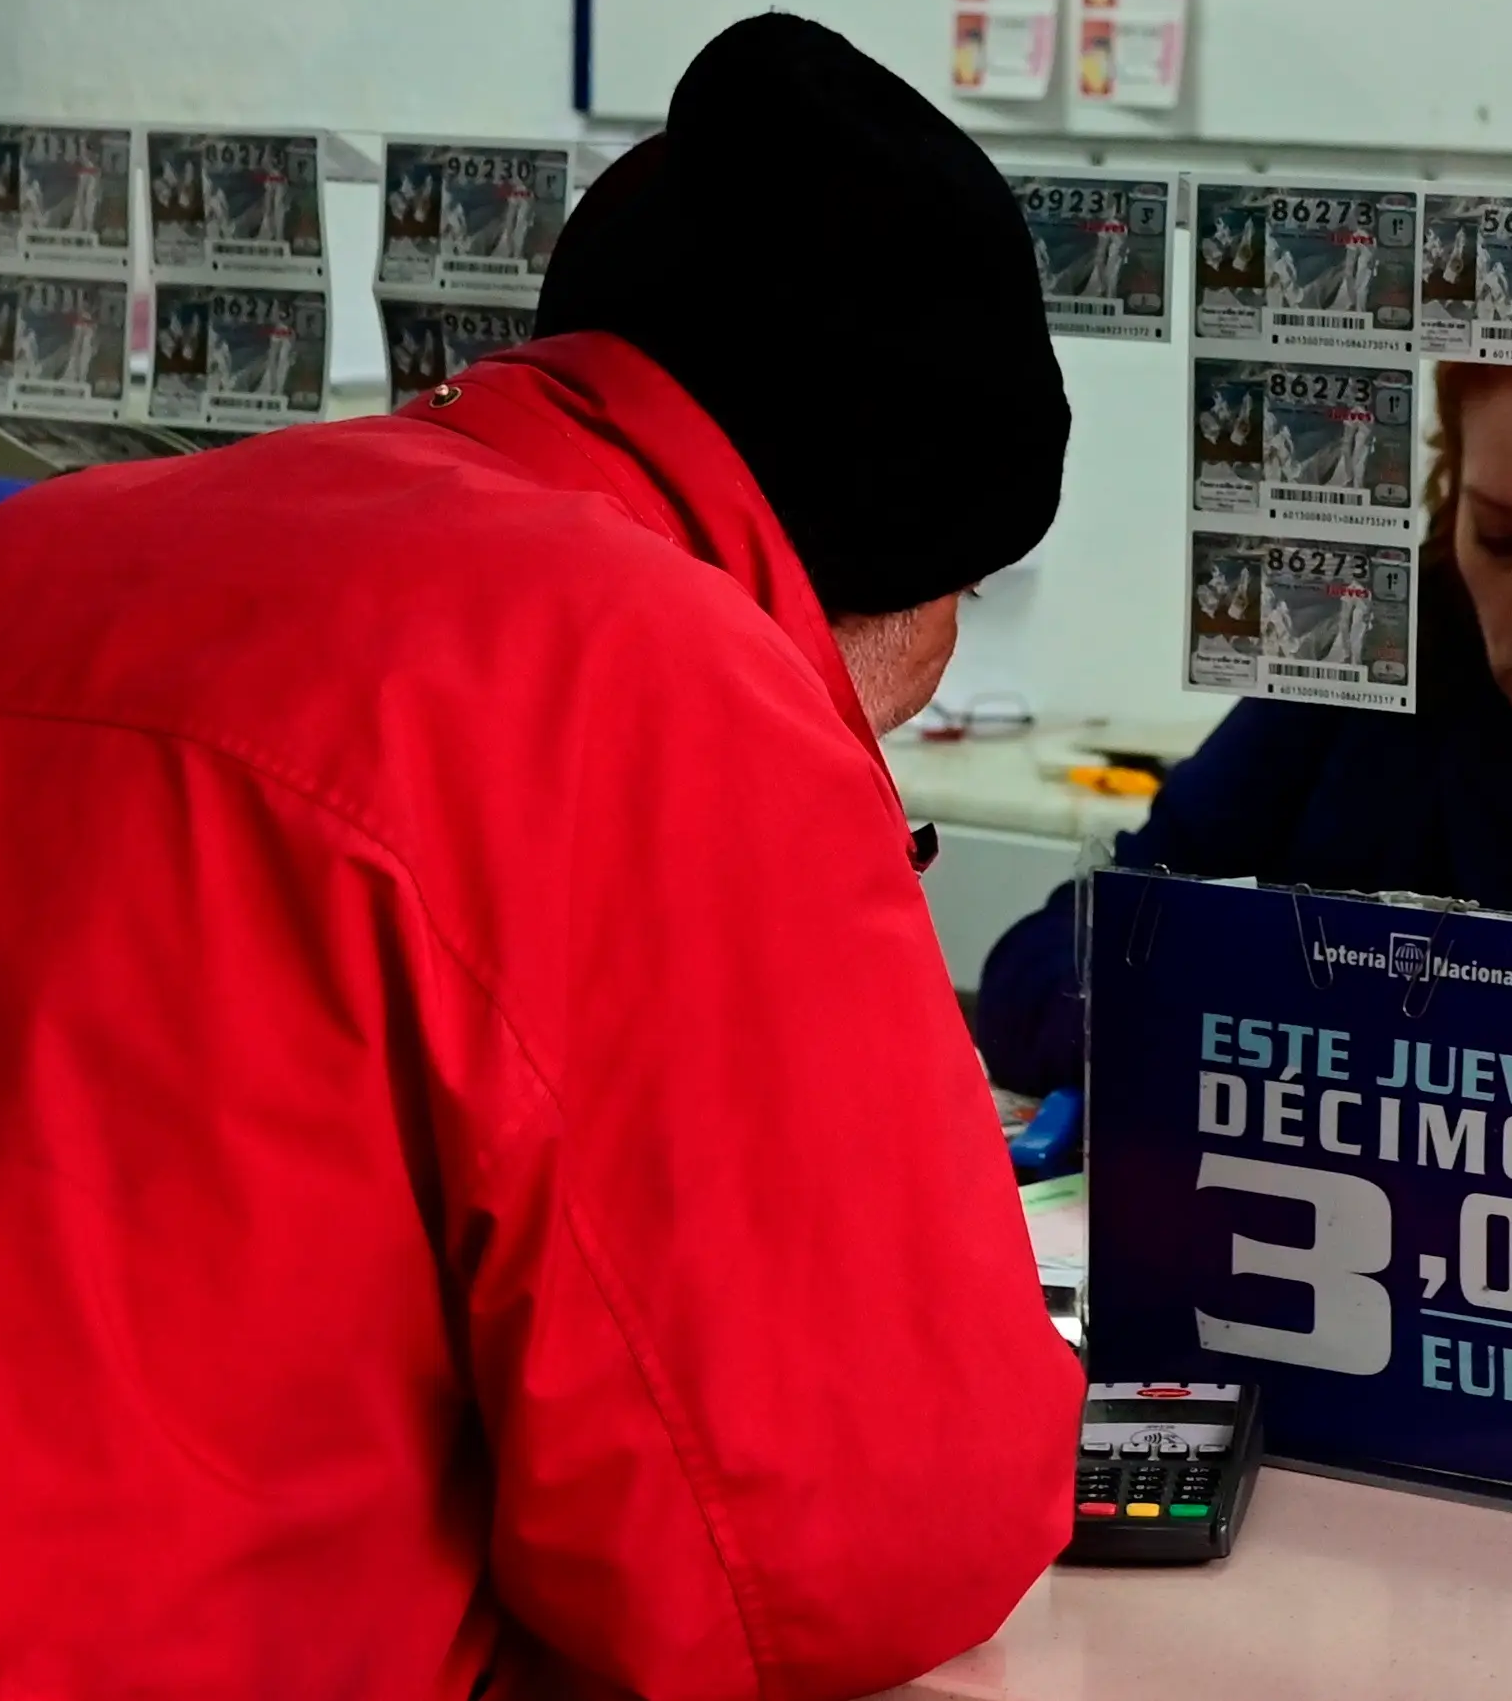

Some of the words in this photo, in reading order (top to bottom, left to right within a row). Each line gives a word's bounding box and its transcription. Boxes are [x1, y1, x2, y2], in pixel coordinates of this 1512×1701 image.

[1271, 200, 1372, 225] 86273
[1313, 941, 1386, 970] Lotería
[1201, 1012, 1351, 1081] ESTE
